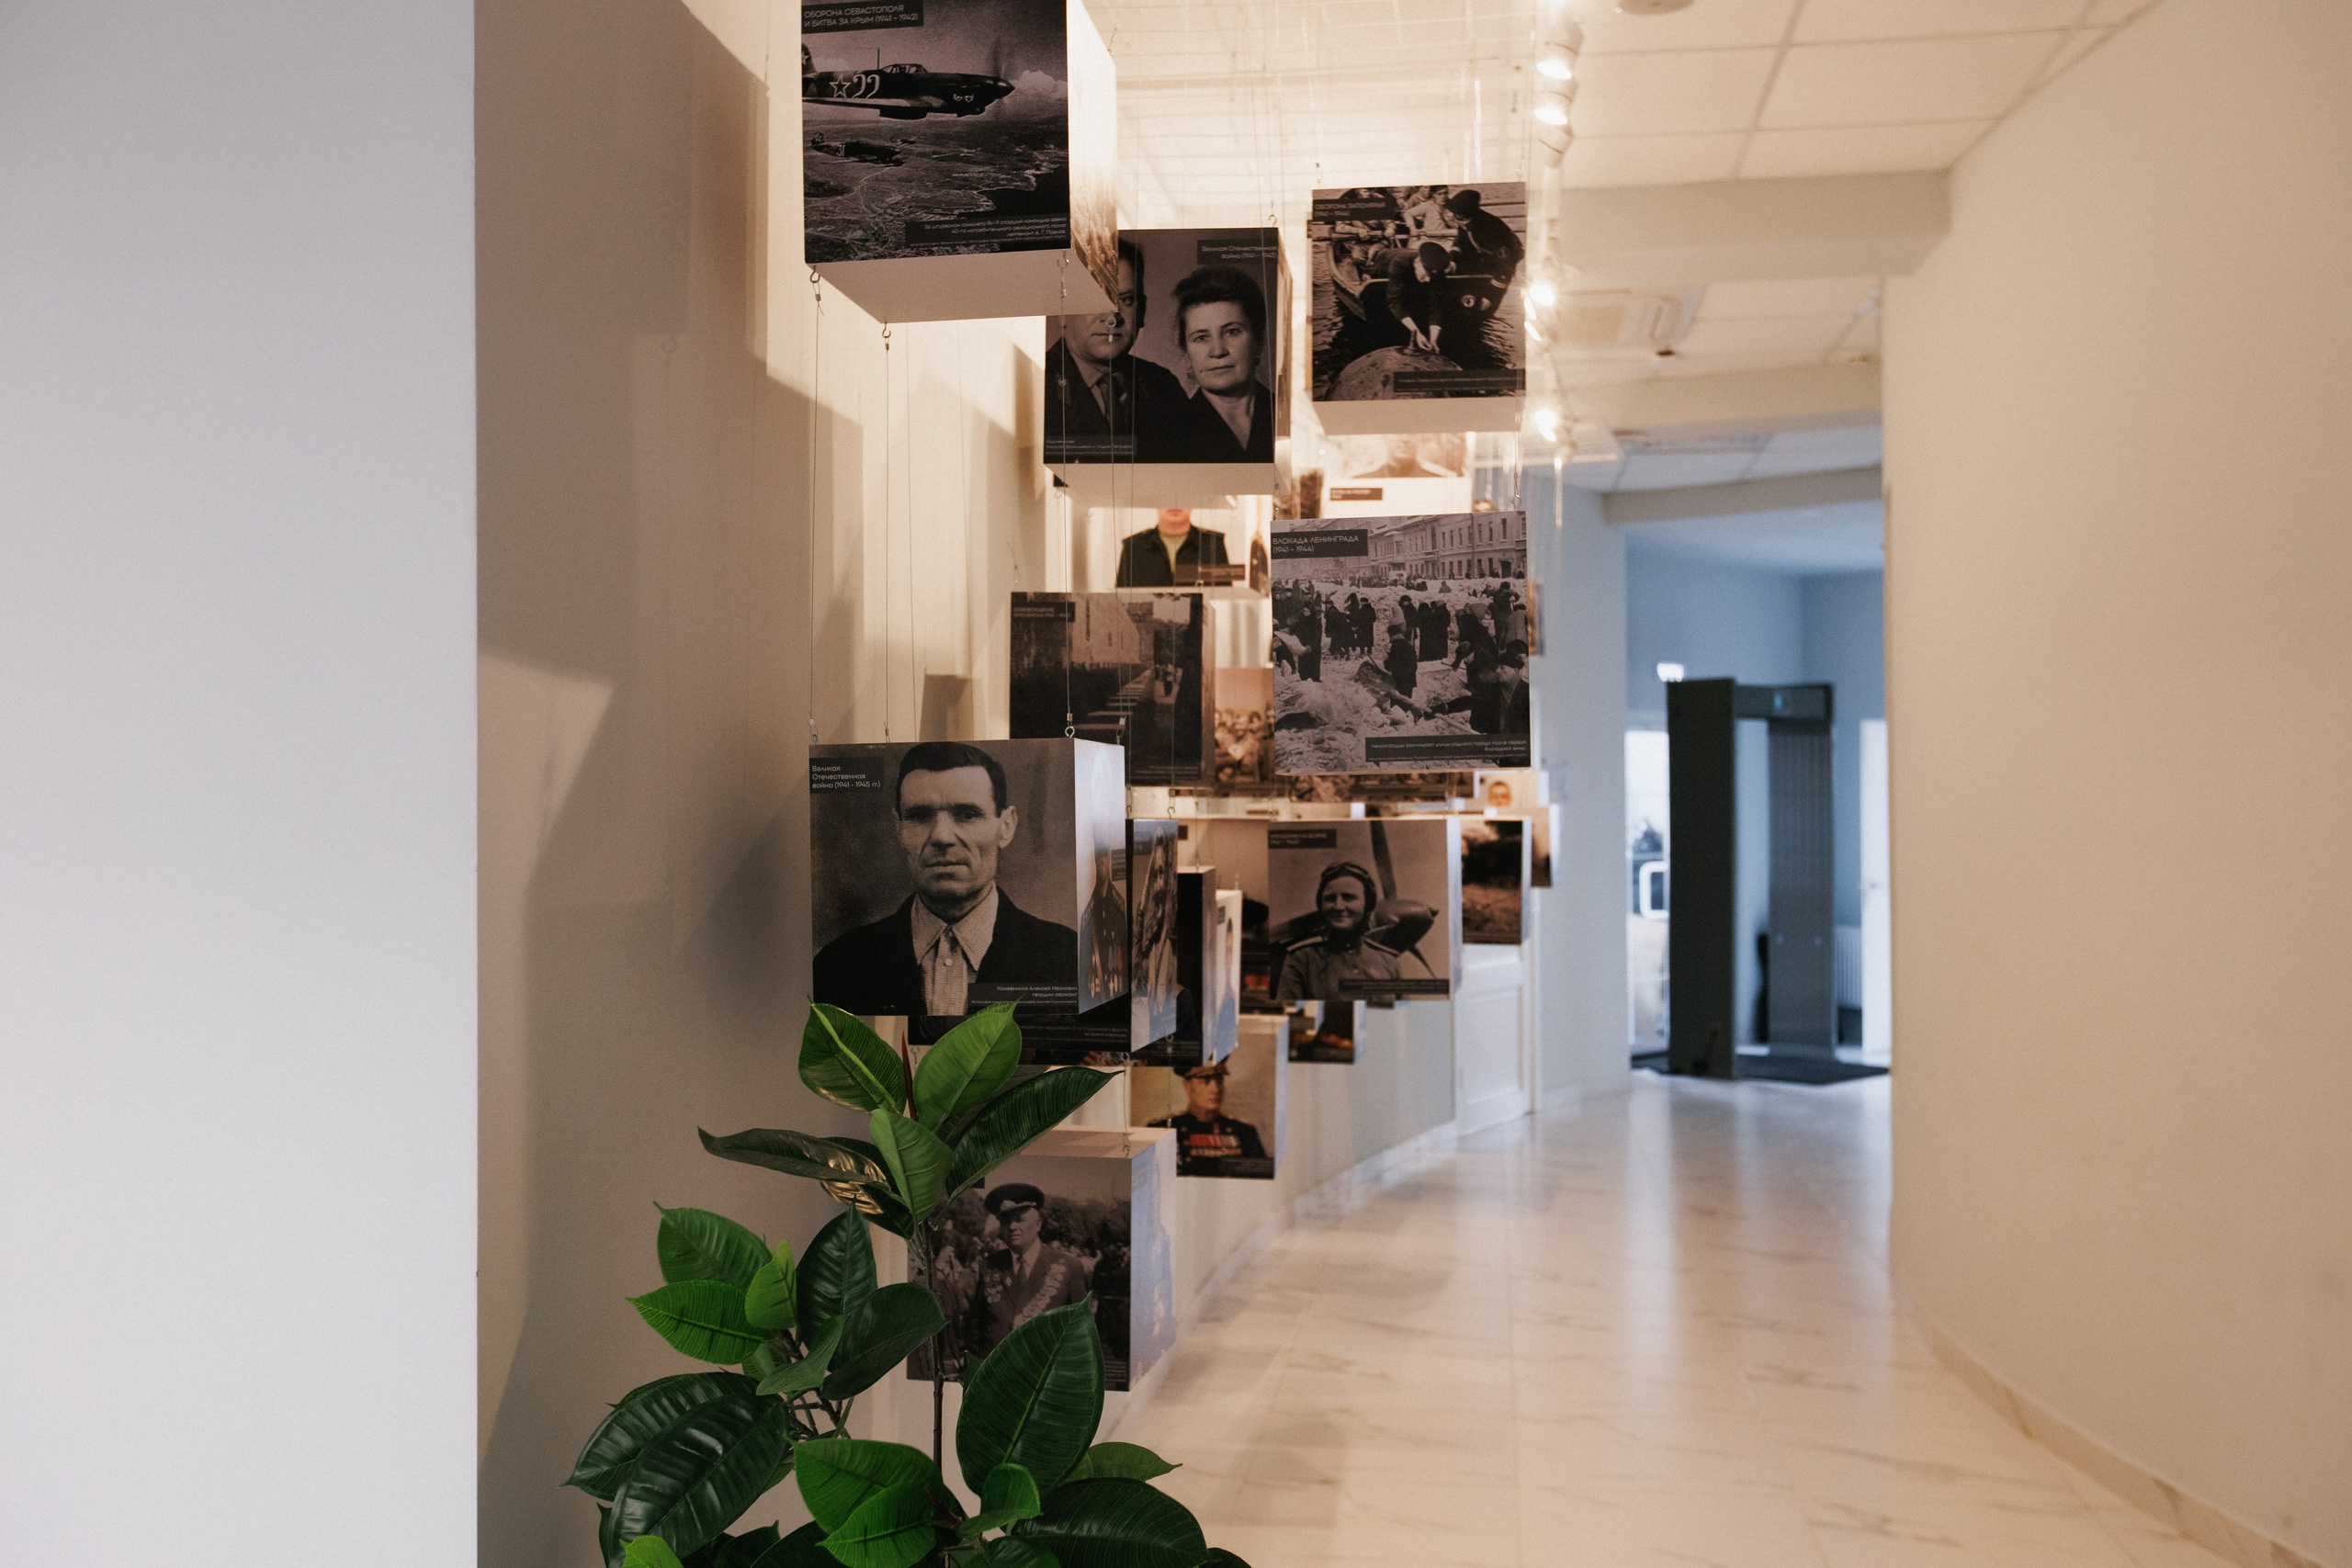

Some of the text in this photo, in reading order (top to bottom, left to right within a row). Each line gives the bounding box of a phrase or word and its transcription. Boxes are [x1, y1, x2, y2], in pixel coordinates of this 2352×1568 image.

[804, 5, 904, 18] ОБОРОНА СЕВАСТОПОЛЯ
[811, 18, 837, 28] БИТВА
[1309, 536, 1359, 544] ЛЕНИНГРАДА
[1272, 546, 1289, 554] (1941
[1296, 545, 1315, 553] 1944)
[834, 781, 850, 790] (1941
